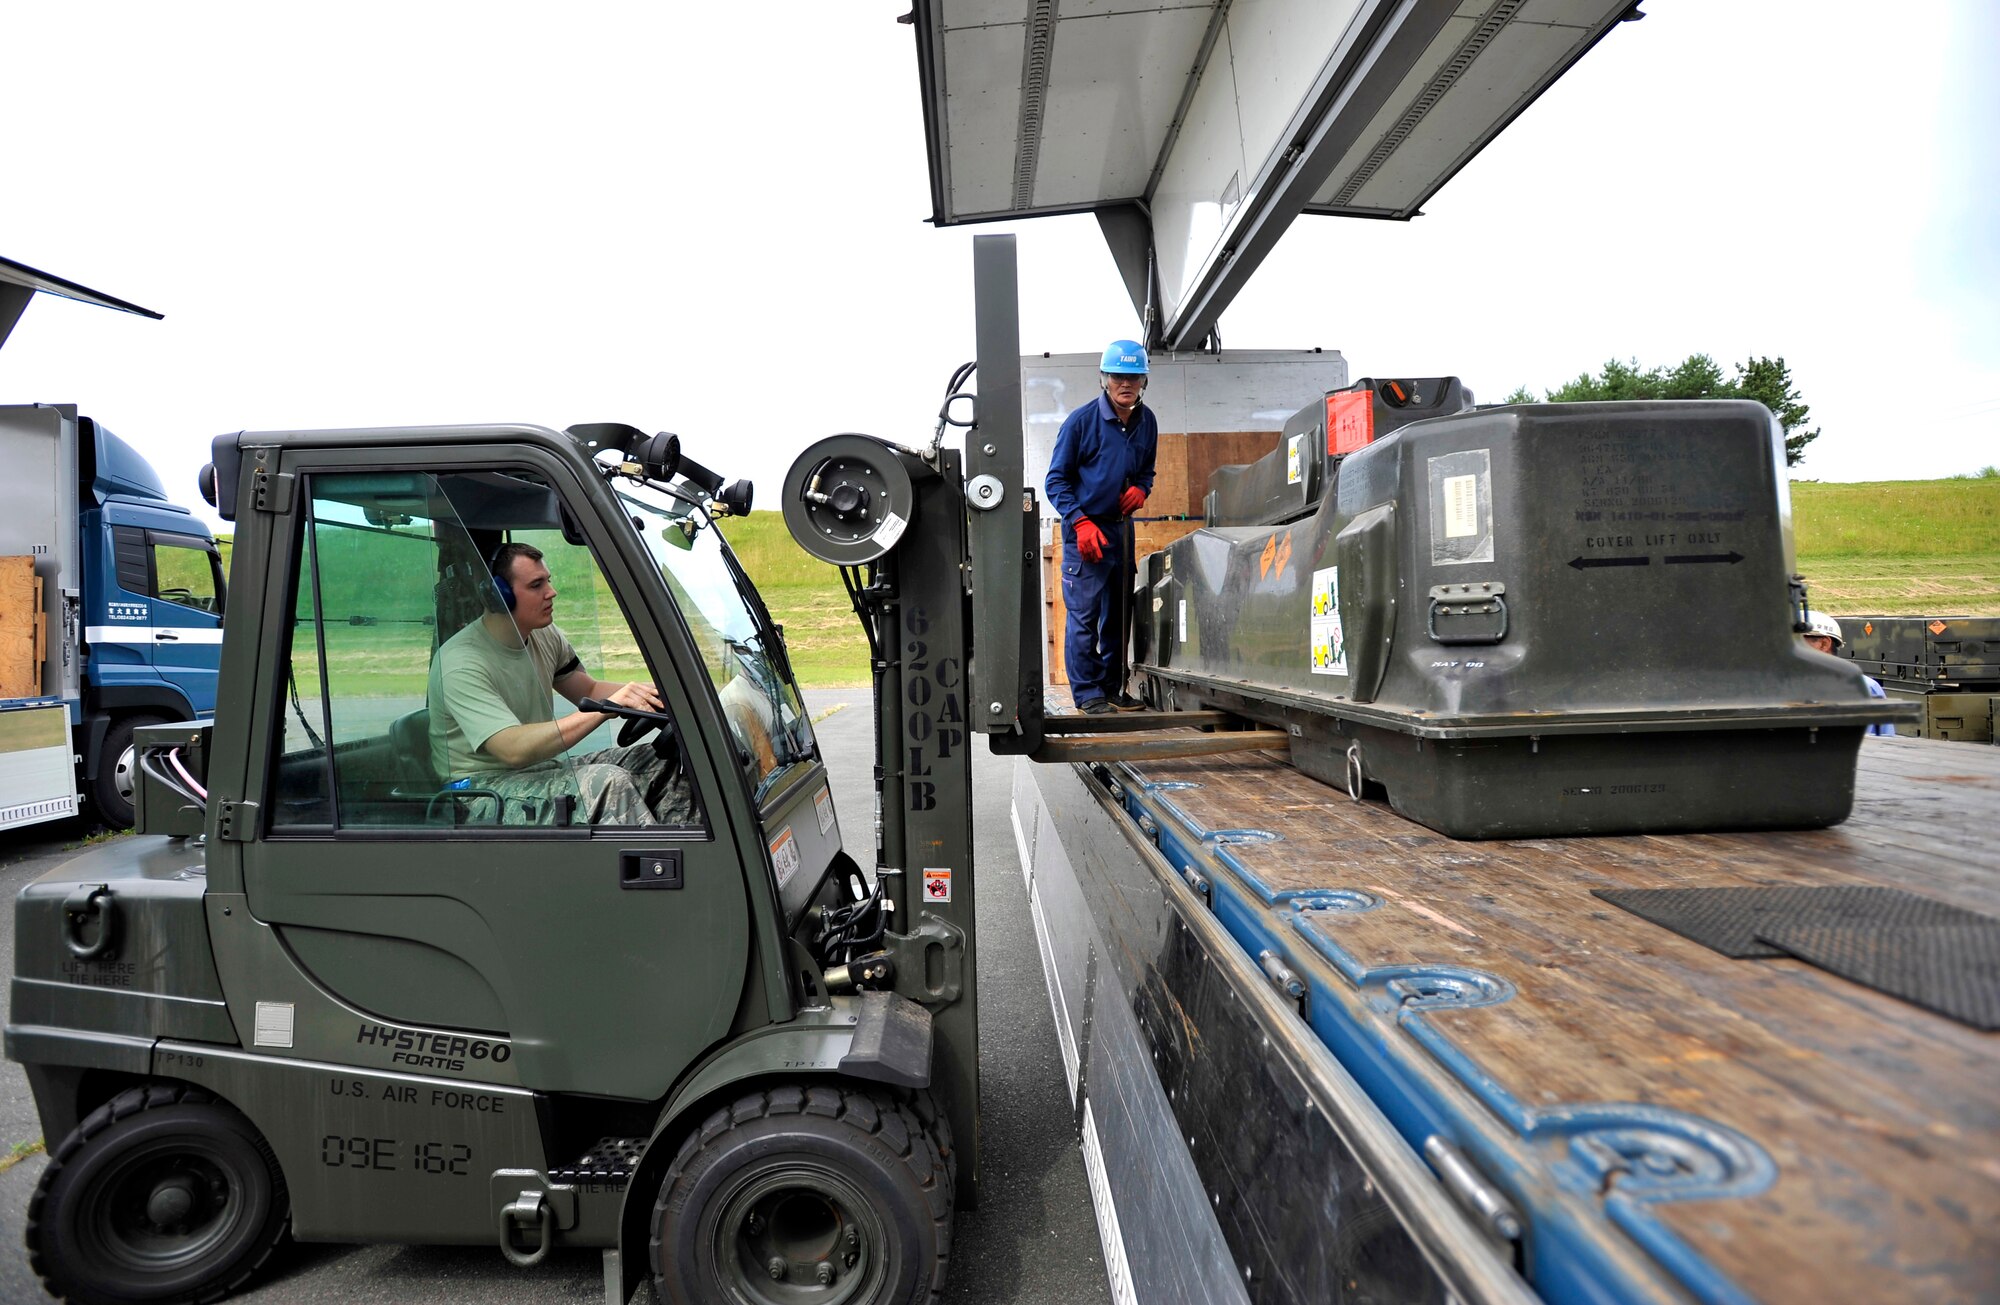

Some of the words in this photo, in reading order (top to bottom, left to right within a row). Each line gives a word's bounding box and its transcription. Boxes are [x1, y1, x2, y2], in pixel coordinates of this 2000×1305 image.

[1586, 535, 1634, 548] COVER
[1645, 533, 1676, 546] LIFT
[1688, 532, 1721, 544] ONLY
[935, 657, 963, 758] CAP
[62, 961, 90, 973] LIFT
[98, 962, 136, 975] HERE
[68, 973, 89, 985] TIE
[93, 974, 131, 986] HERE
[156, 1051, 204, 1068] TP130
[392, 1052, 465, 1071] FORTIS
[329, 1079, 369, 1099] U.S.
[382, 1085, 418, 1104] AIR
[431, 1090, 505, 1113] FORCE
[414, 1142, 472, 1175] 162
[604, 1184, 626, 1193] HE
